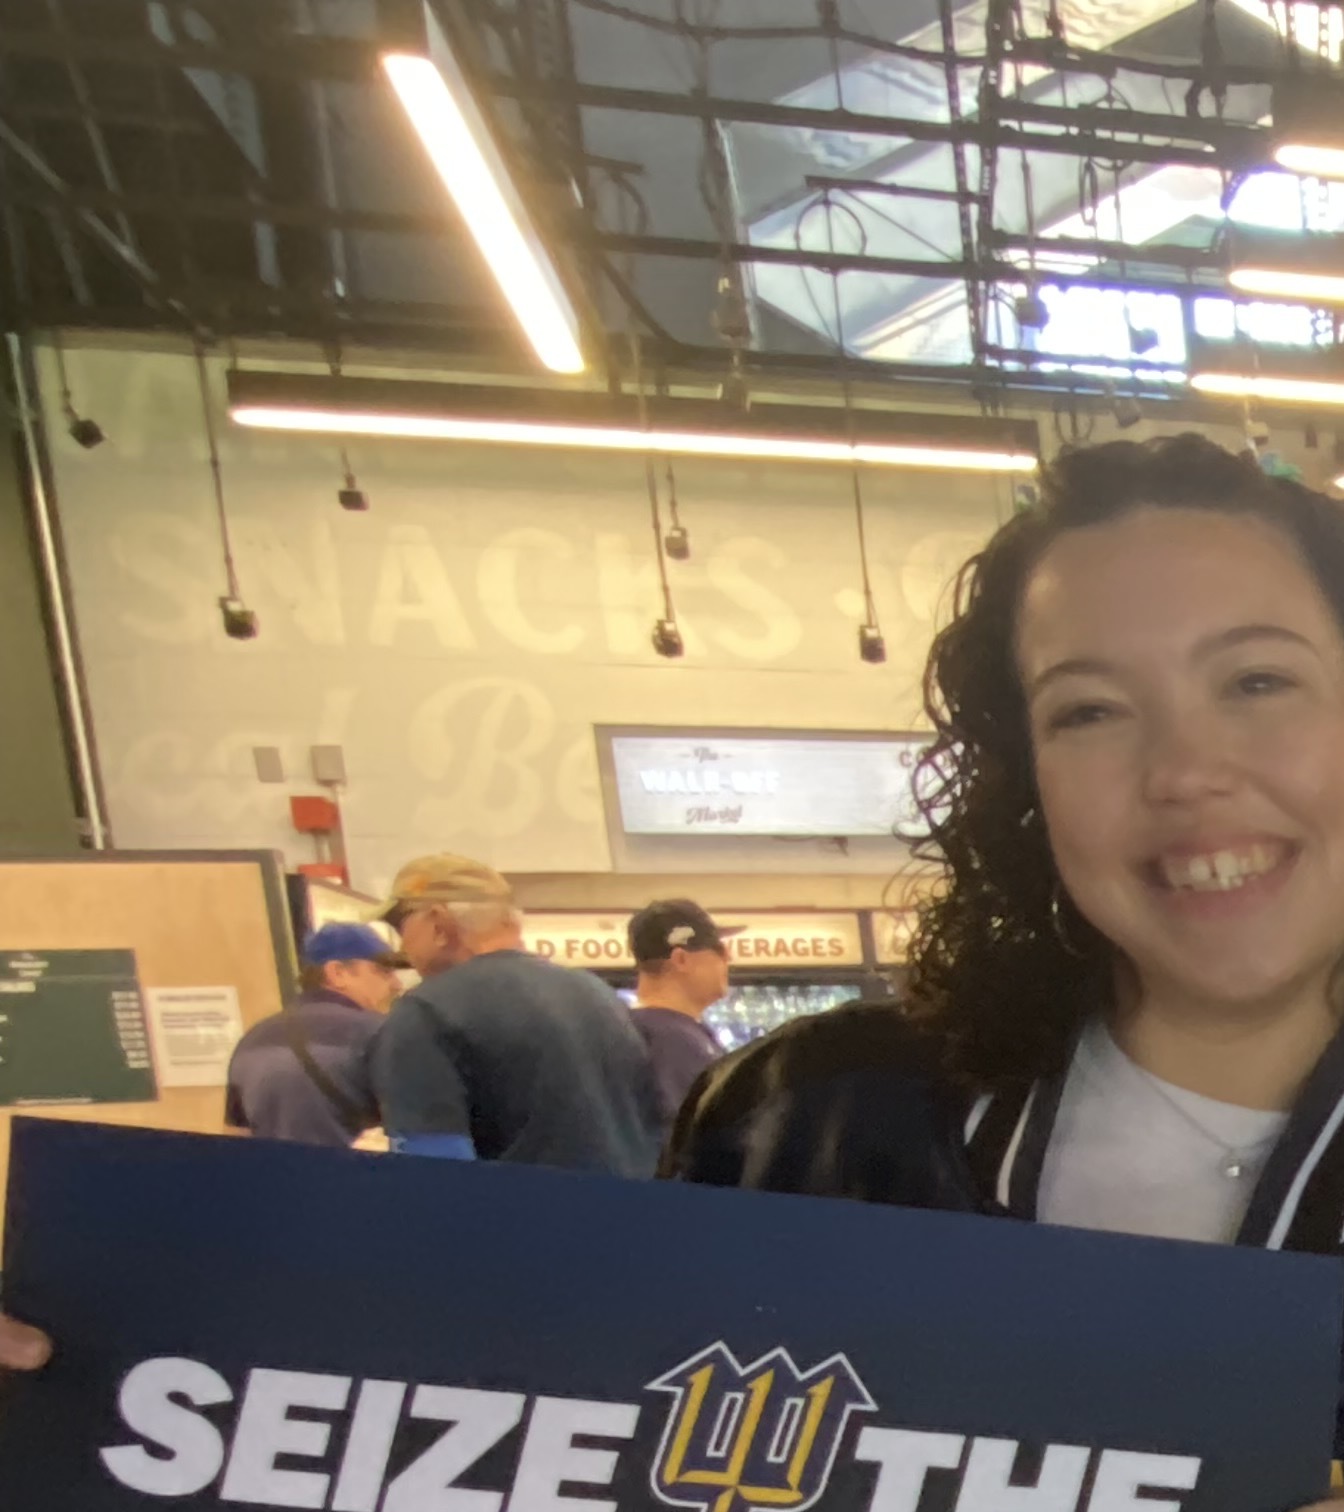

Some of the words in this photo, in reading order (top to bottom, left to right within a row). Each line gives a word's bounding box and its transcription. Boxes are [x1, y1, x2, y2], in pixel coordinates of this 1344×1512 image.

[109, 510, 804, 661] SNACKS
[565, 938, 631, 959] FOO
[727, 937, 845, 958] VERAGES
